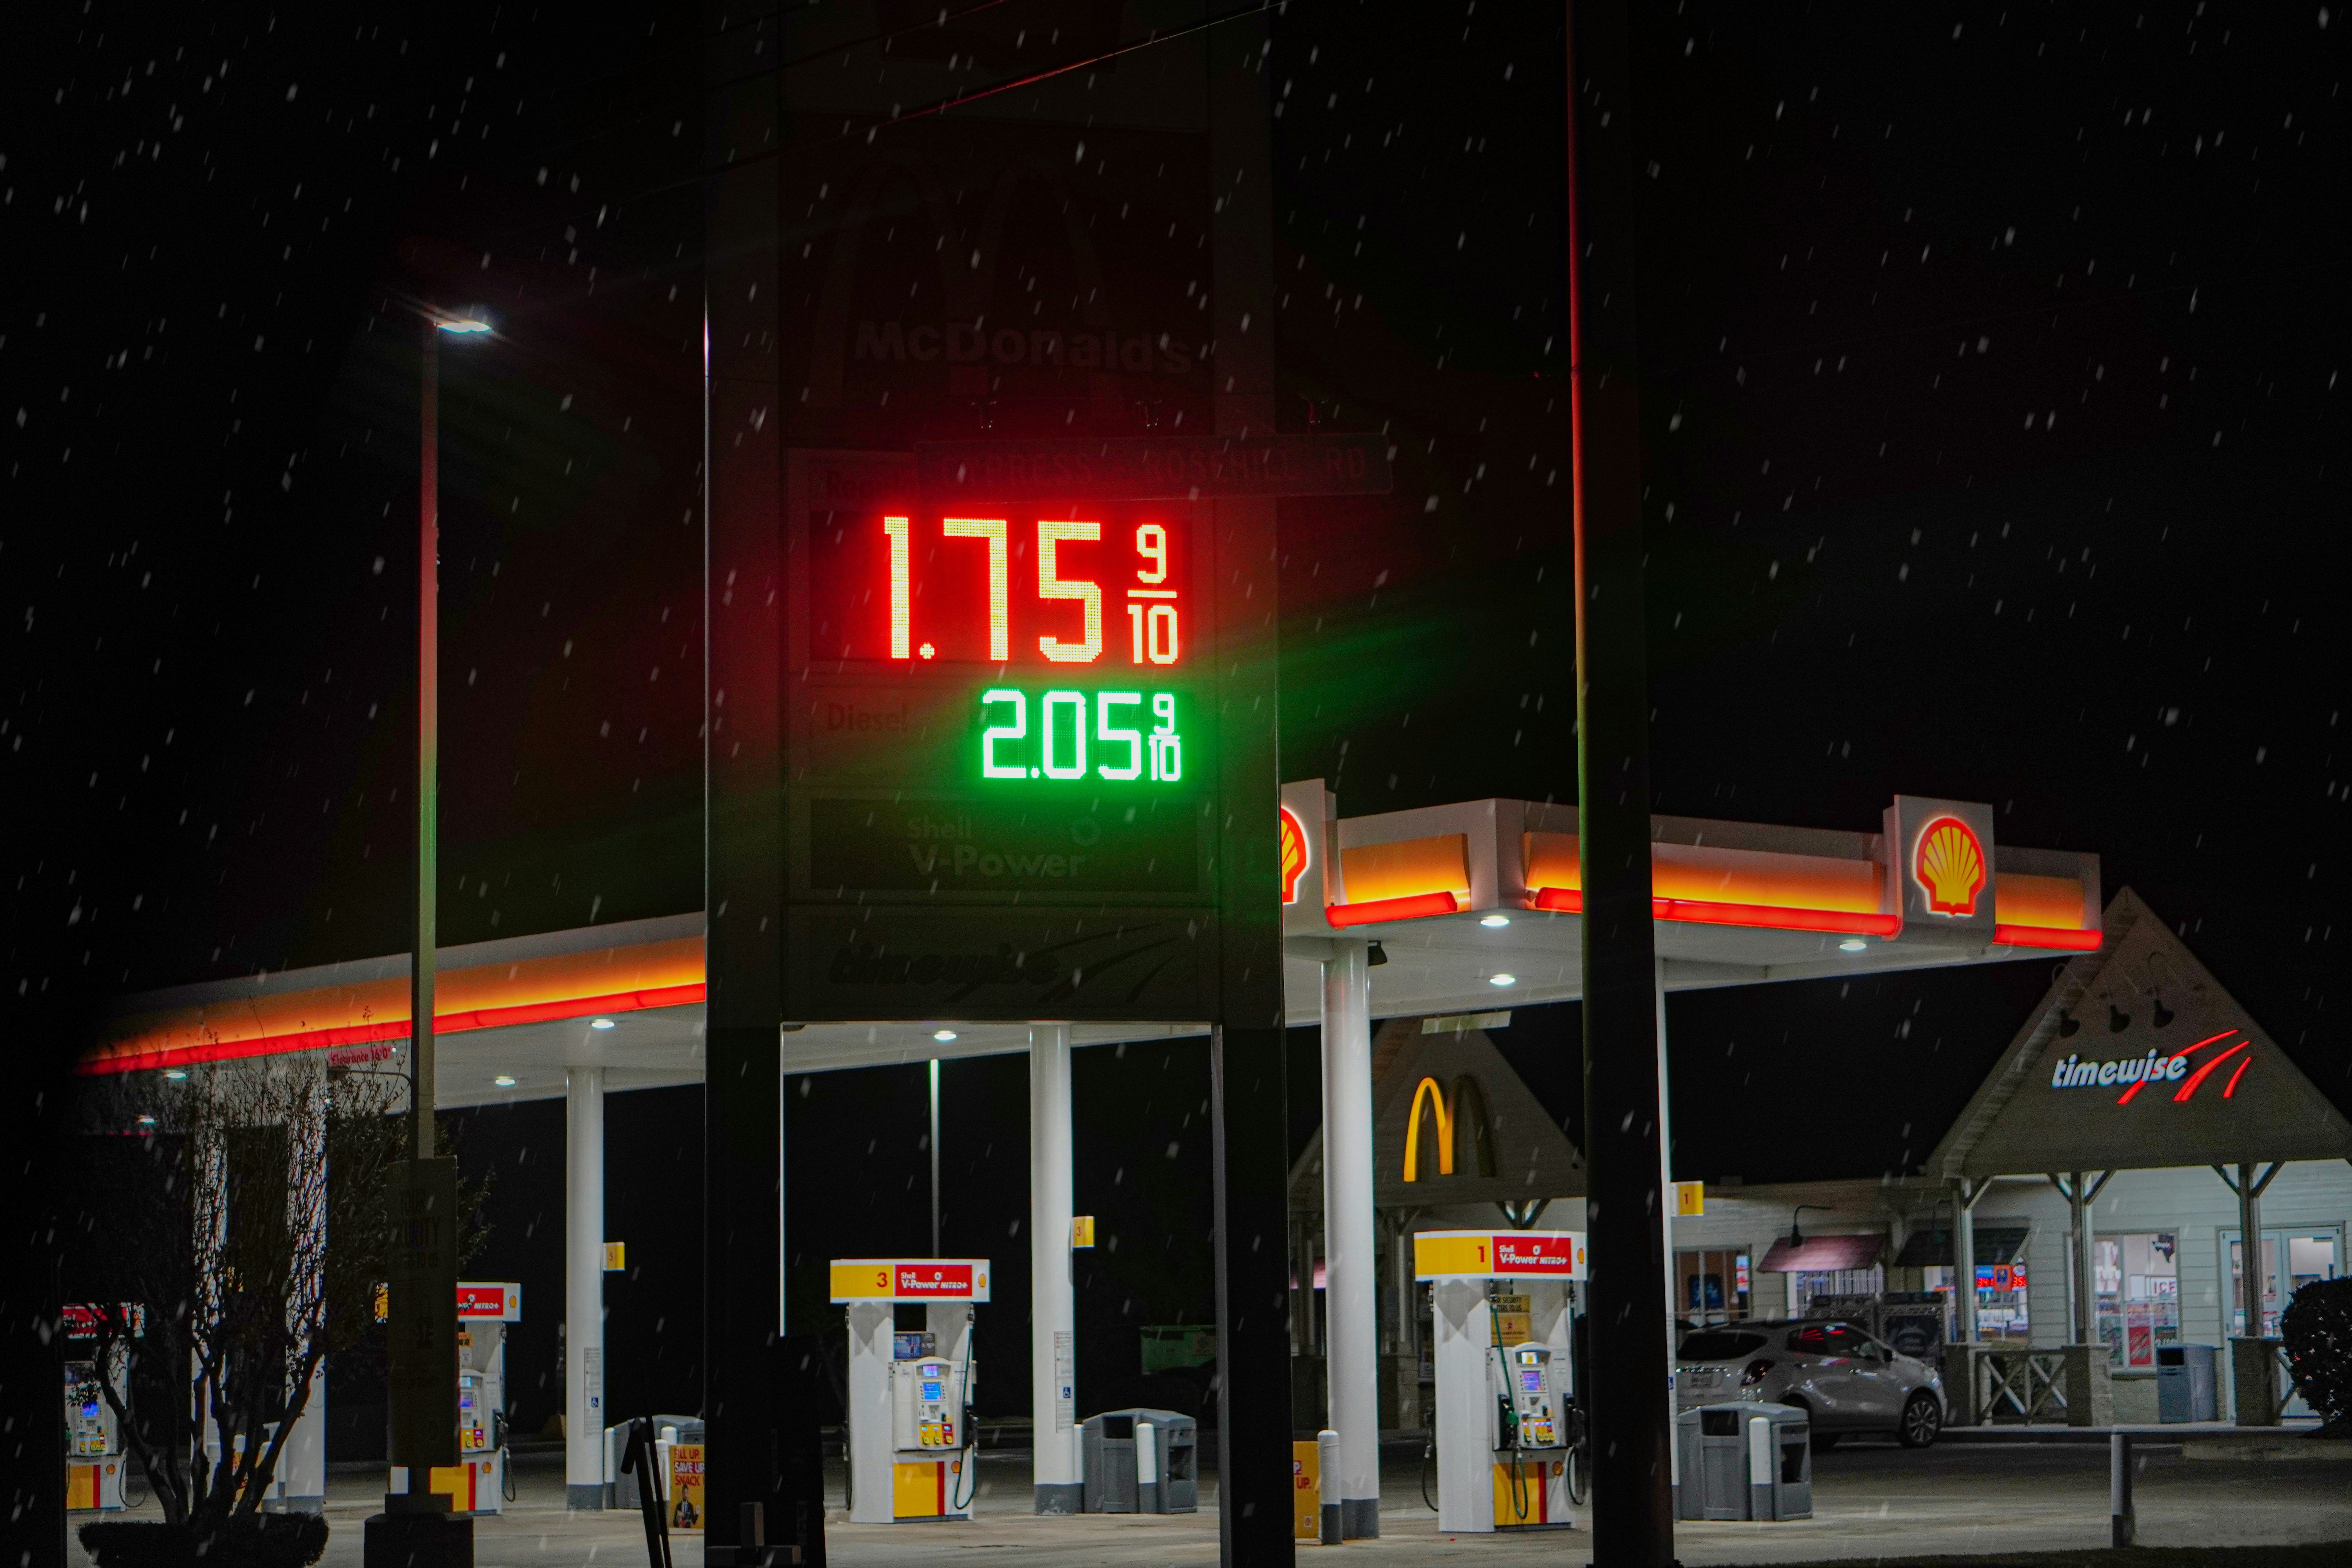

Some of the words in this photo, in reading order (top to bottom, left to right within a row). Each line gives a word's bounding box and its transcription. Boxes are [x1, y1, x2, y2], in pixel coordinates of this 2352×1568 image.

[1325, 446, 1367, 479] RD
[826, 470, 917, 503] Regula
[884, 515, 1102, 662] 1.75
[827, 702, 908, 733] Diesel
[983, 689, 1141, 780] 2.05
[907, 816, 973, 840] Shell
[908, 844, 1086, 877] V-Power
[2051, 1048, 2188, 1088] timewise
[1684, 1193, 1688, 1205] 1
[1477, 1245, 1485, 1262] 1
[1499, 1245, 1515, 1253] Shell
[1499, 1254, 1539, 1264] V-Power
[876, 1272, 887, 1287] 3
[901, 1280, 938, 1289] V-Power
[2154, 1281, 2176, 1294] ICE
[675, 1462, 694, 1473] SAVE
[675, 1475, 701, 1486] SNACK
